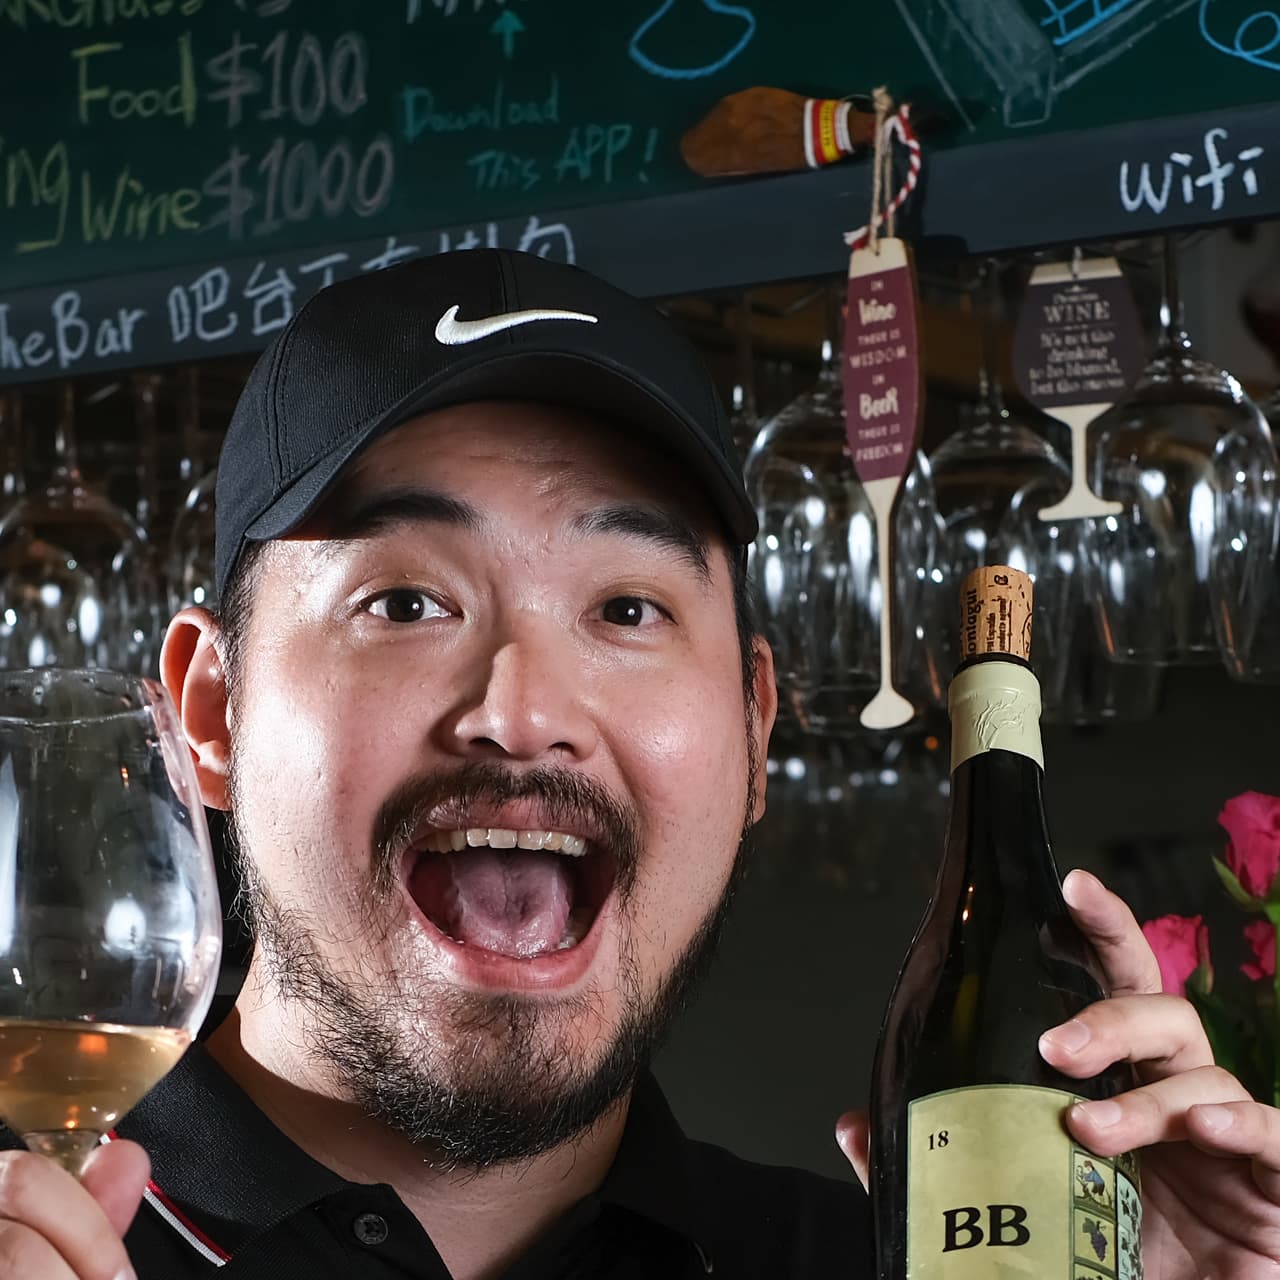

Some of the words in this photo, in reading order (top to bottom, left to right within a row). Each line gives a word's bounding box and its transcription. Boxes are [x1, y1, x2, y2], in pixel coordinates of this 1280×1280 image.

[70, 30, 198, 129] Food
[205, 30, 369, 129] $100
[80, 164, 203, 246] Wine
[202, 131, 398, 240] $1000
[466, 147, 541, 191] This
[1119, 129, 1264, 214] Wifi
[1042, 300, 1110, 323] WINE
[849, 346, 907, 369] WISDOM
[855, 442, 904, 462] FREEDOM
[966, 588, 981, 656] ontagut
[927, 1130, 950, 1151] 18
[942, 1204, 1031, 1253] BB
